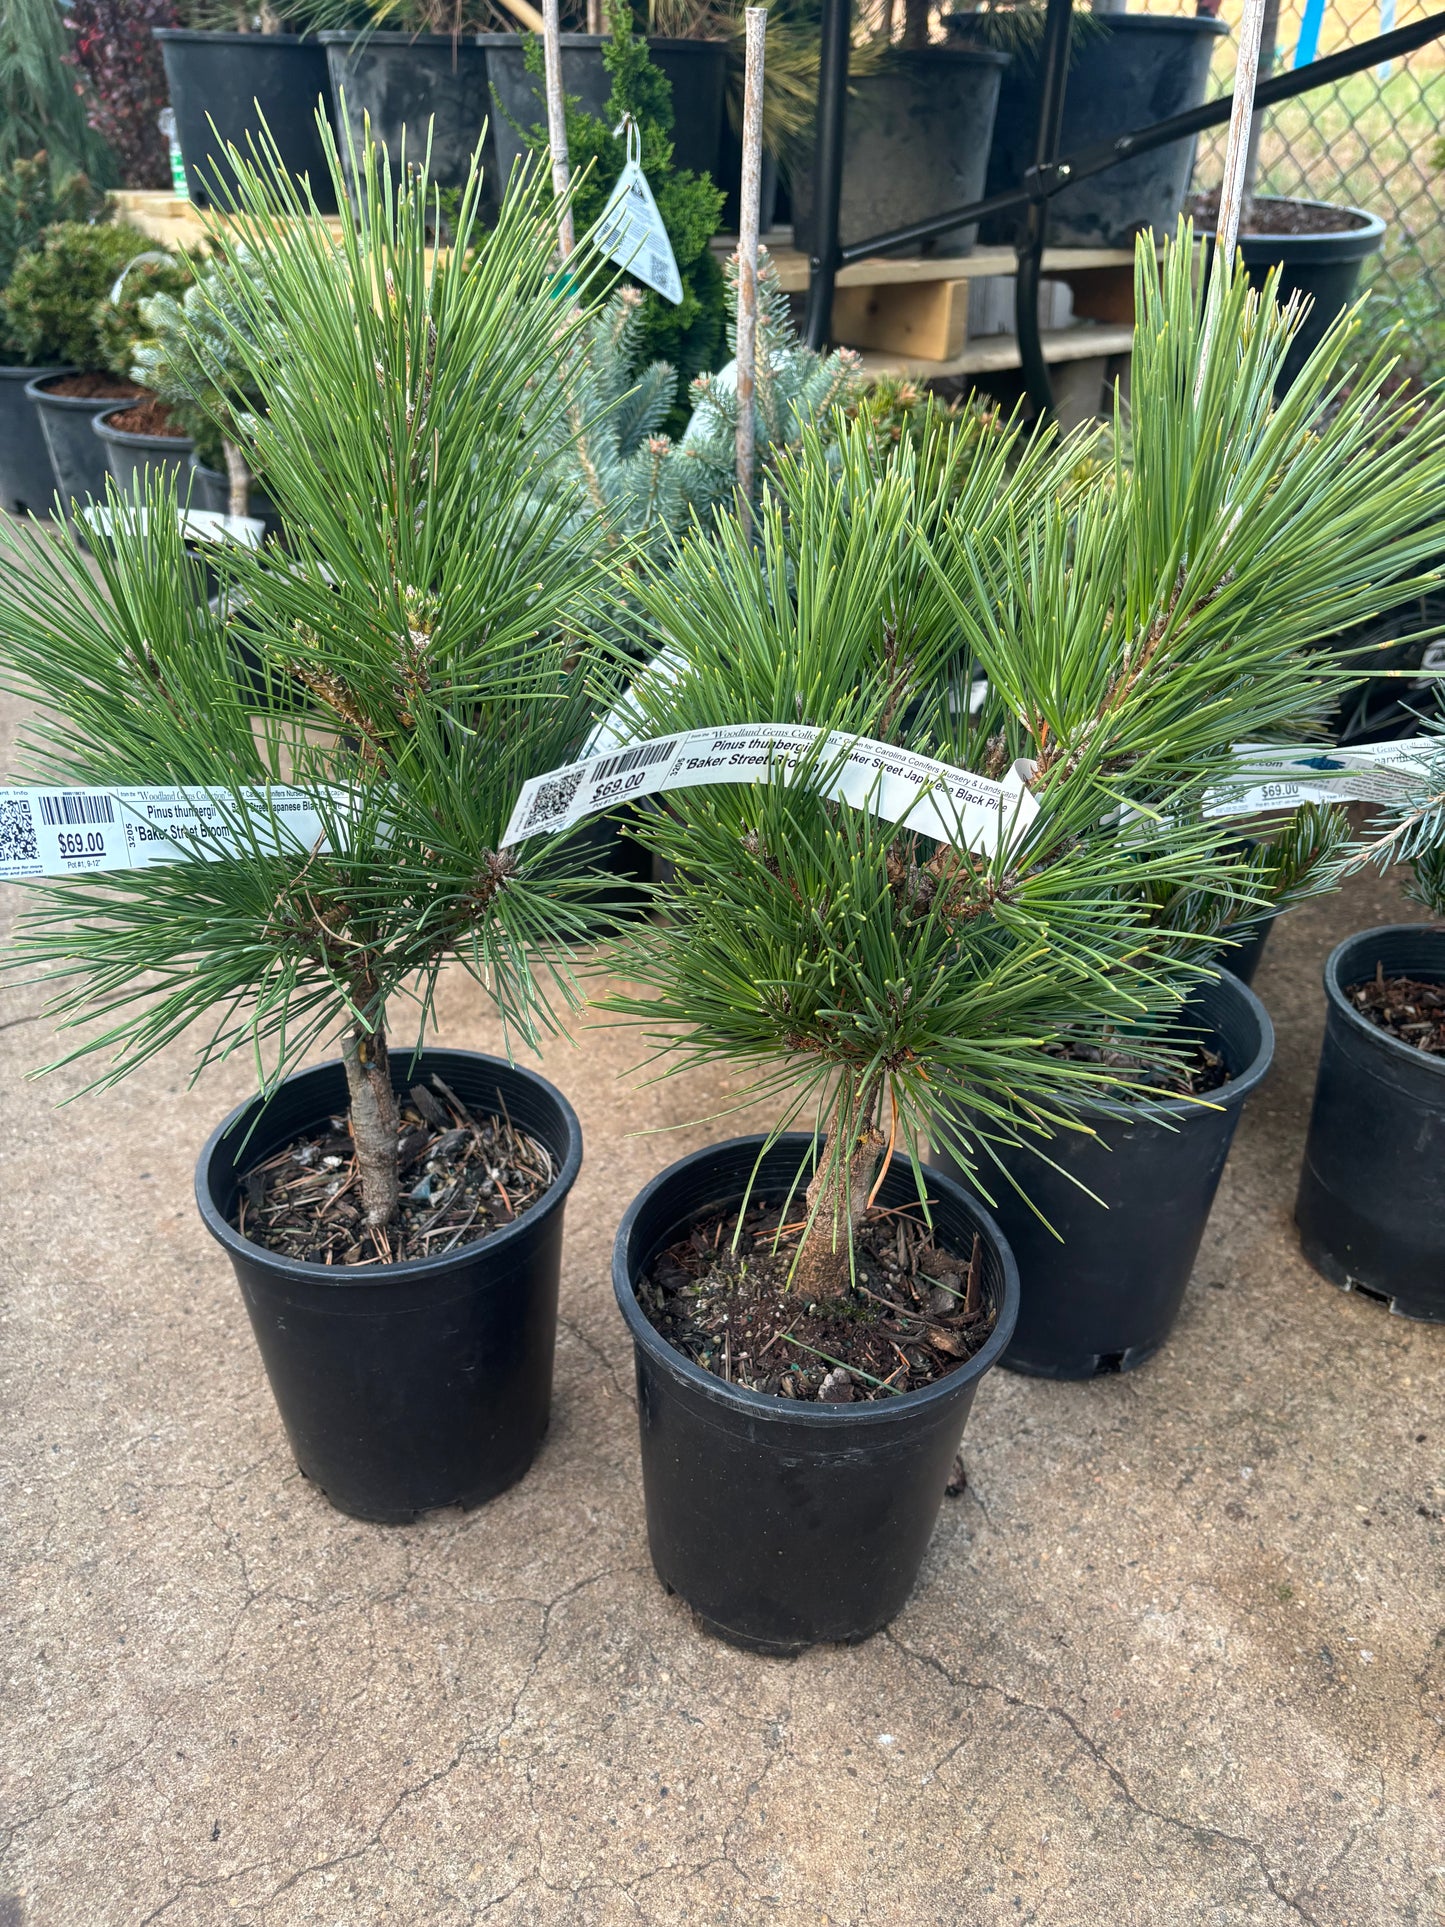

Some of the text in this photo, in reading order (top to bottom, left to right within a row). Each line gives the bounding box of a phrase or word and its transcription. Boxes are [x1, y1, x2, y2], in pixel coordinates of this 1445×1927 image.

[711, 739, 747, 752] Pinus
[670, 757, 686, 777] 3205
[686, 755, 727, 770] 'Baker
[728, 753, 769, 767] Street
[711, 726, 762, 739] "Woodland
[763, 726, 789, 737] Gems
[864, 743, 874, 751] for
[874, 746, 907, 762] Carolina
[908, 757, 940, 774] Conifers
[941, 769, 971, 786] Nursery
[971, 779, 978, 787] &
[979, 781, 1018, 800] Landscape
[593, 771, 646, 801] $69.00
[871, 758, 904, 776] Street
[955, 788, 985, 806] Black
[1261, 783, 1299, 798] $69.00
[147, 805, 173, 819] Pinus
[57, 832, 105, 856] $69.00
[125, 823, 137, 849] 3205
[67, 861, 78, 869] Pot
